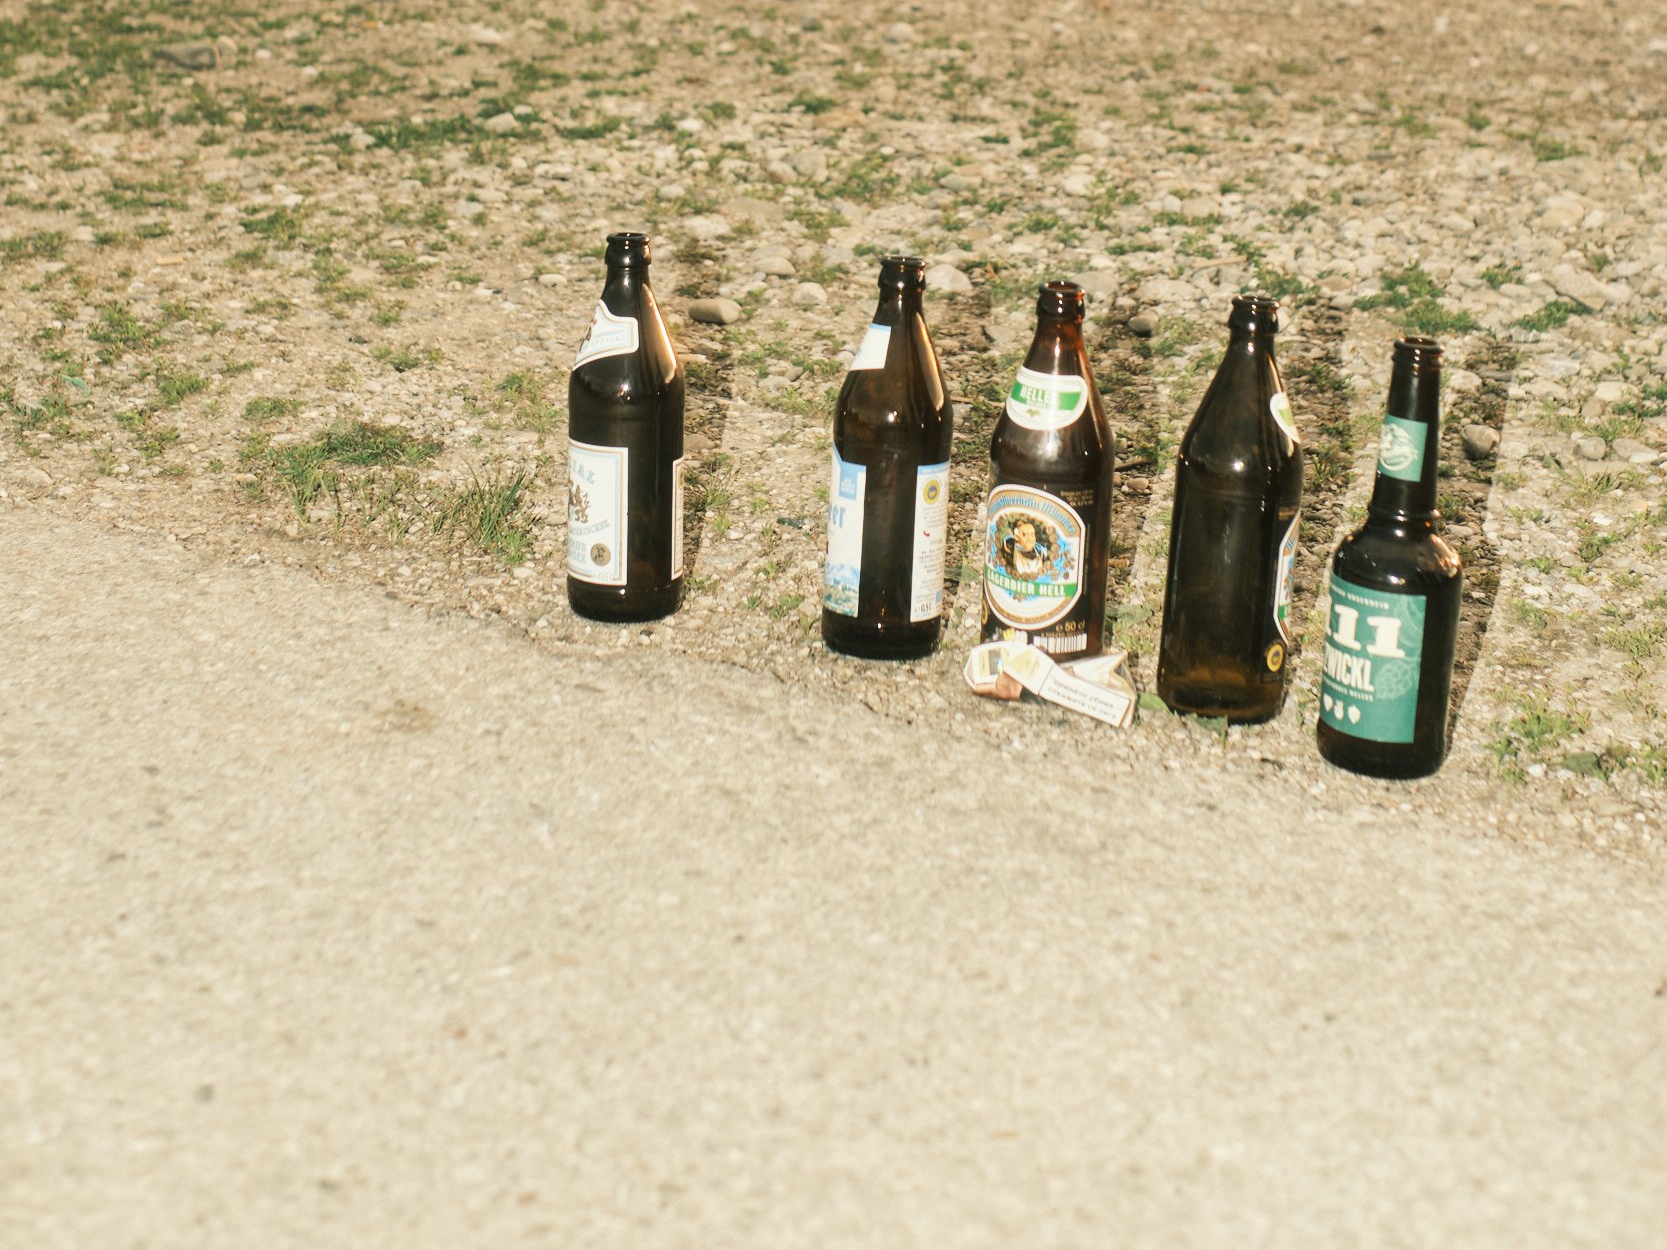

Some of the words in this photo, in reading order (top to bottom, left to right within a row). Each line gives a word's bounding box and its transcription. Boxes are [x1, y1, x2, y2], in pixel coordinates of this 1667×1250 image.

[987, 568, 1035, 595] LAGERBIER
[1039, 583, 1066, 597] HELL
[1326, 600, 1405, 658] 11
